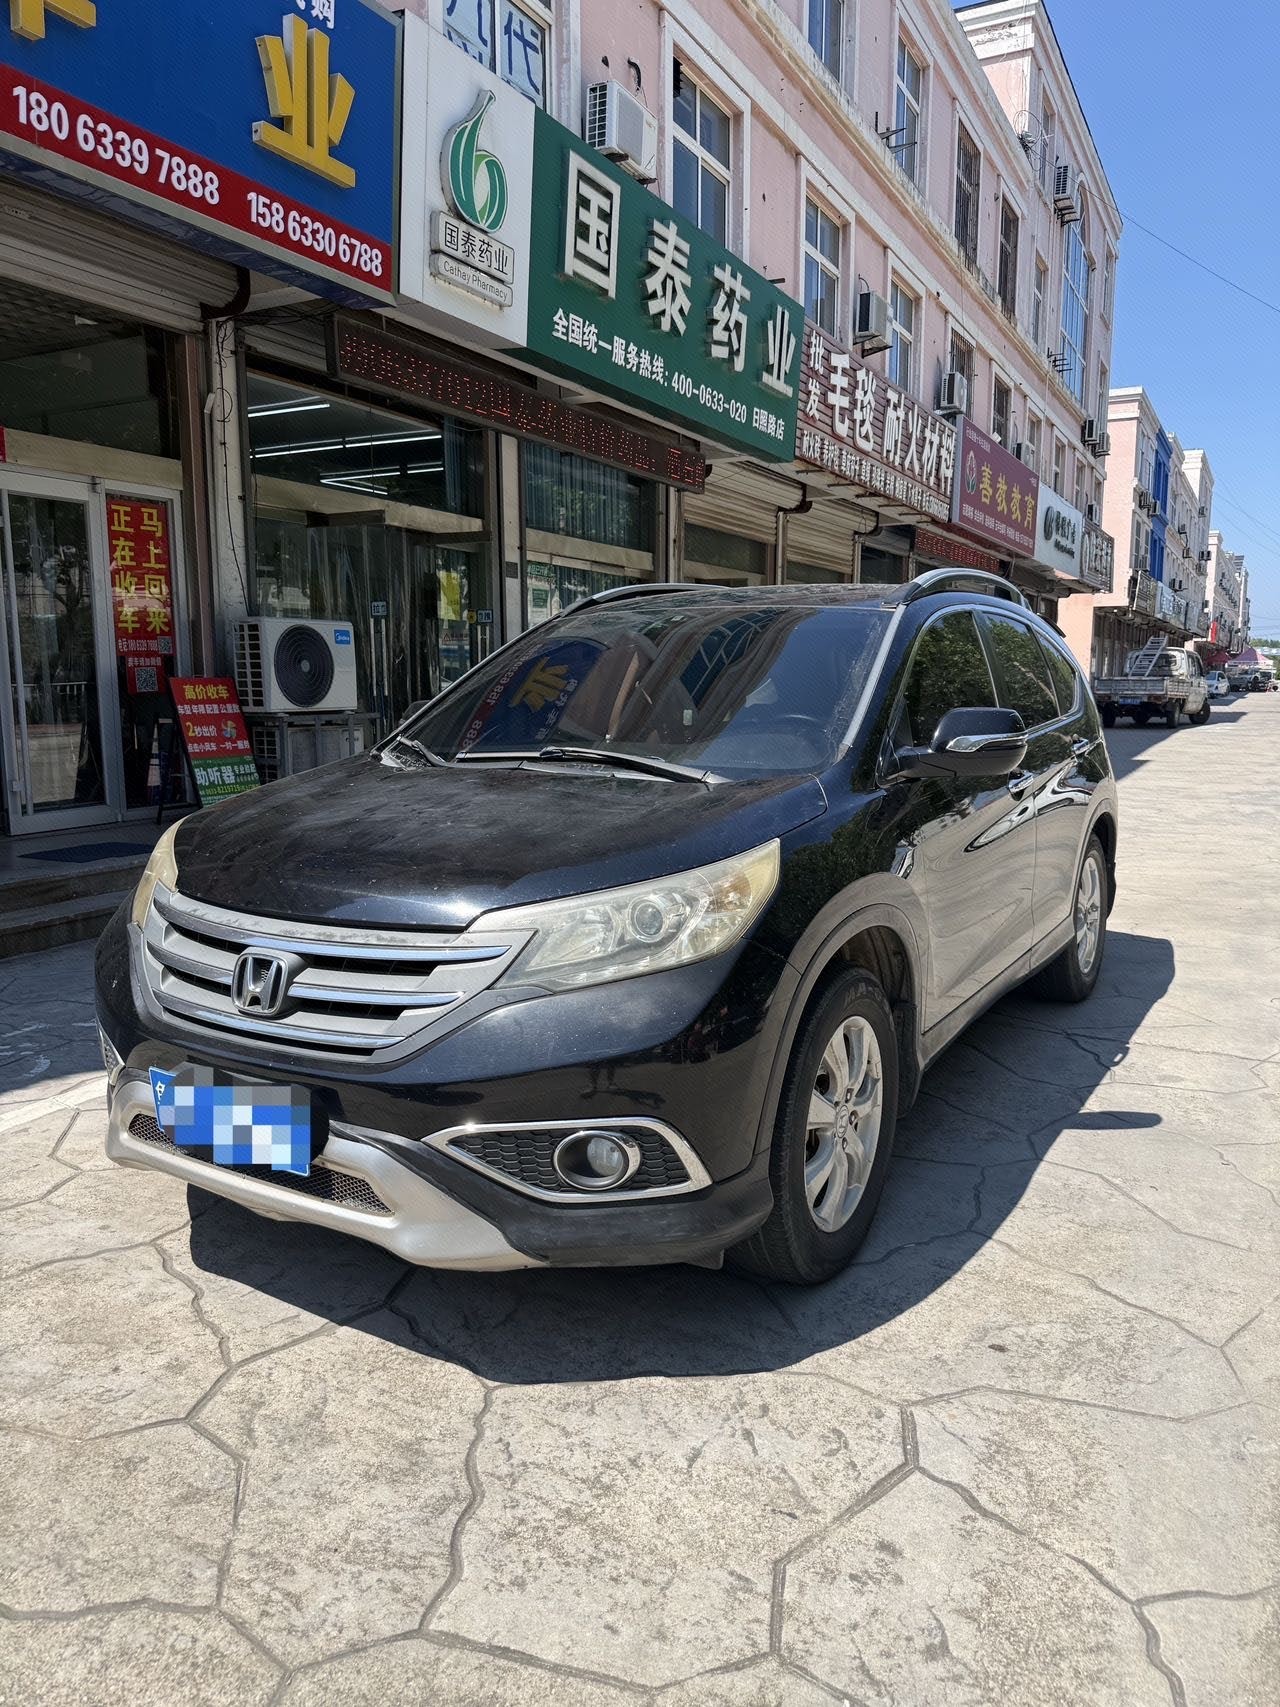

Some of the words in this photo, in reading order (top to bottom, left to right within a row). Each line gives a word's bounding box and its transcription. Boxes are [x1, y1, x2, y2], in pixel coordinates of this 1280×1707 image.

[13, 86, 69, 140] 180
[77, 114, 149, 174] 6339
[155, 148, 220, 205] 7888
[247, 192, 285, 233] 158
[288, 210, 336, 257] 6330
[339, 234, 382, 277] 6788
[445, 221, 509, 276] 国泰药业
[444, 260, 471, 284] Cathay
[472, 274, 508, 302] Pharmacy
[565, 149, 796, 397] 国泰药业
[183, 684, 229, 700] 高价收车
[194, 765, 235, 786] 助听器
